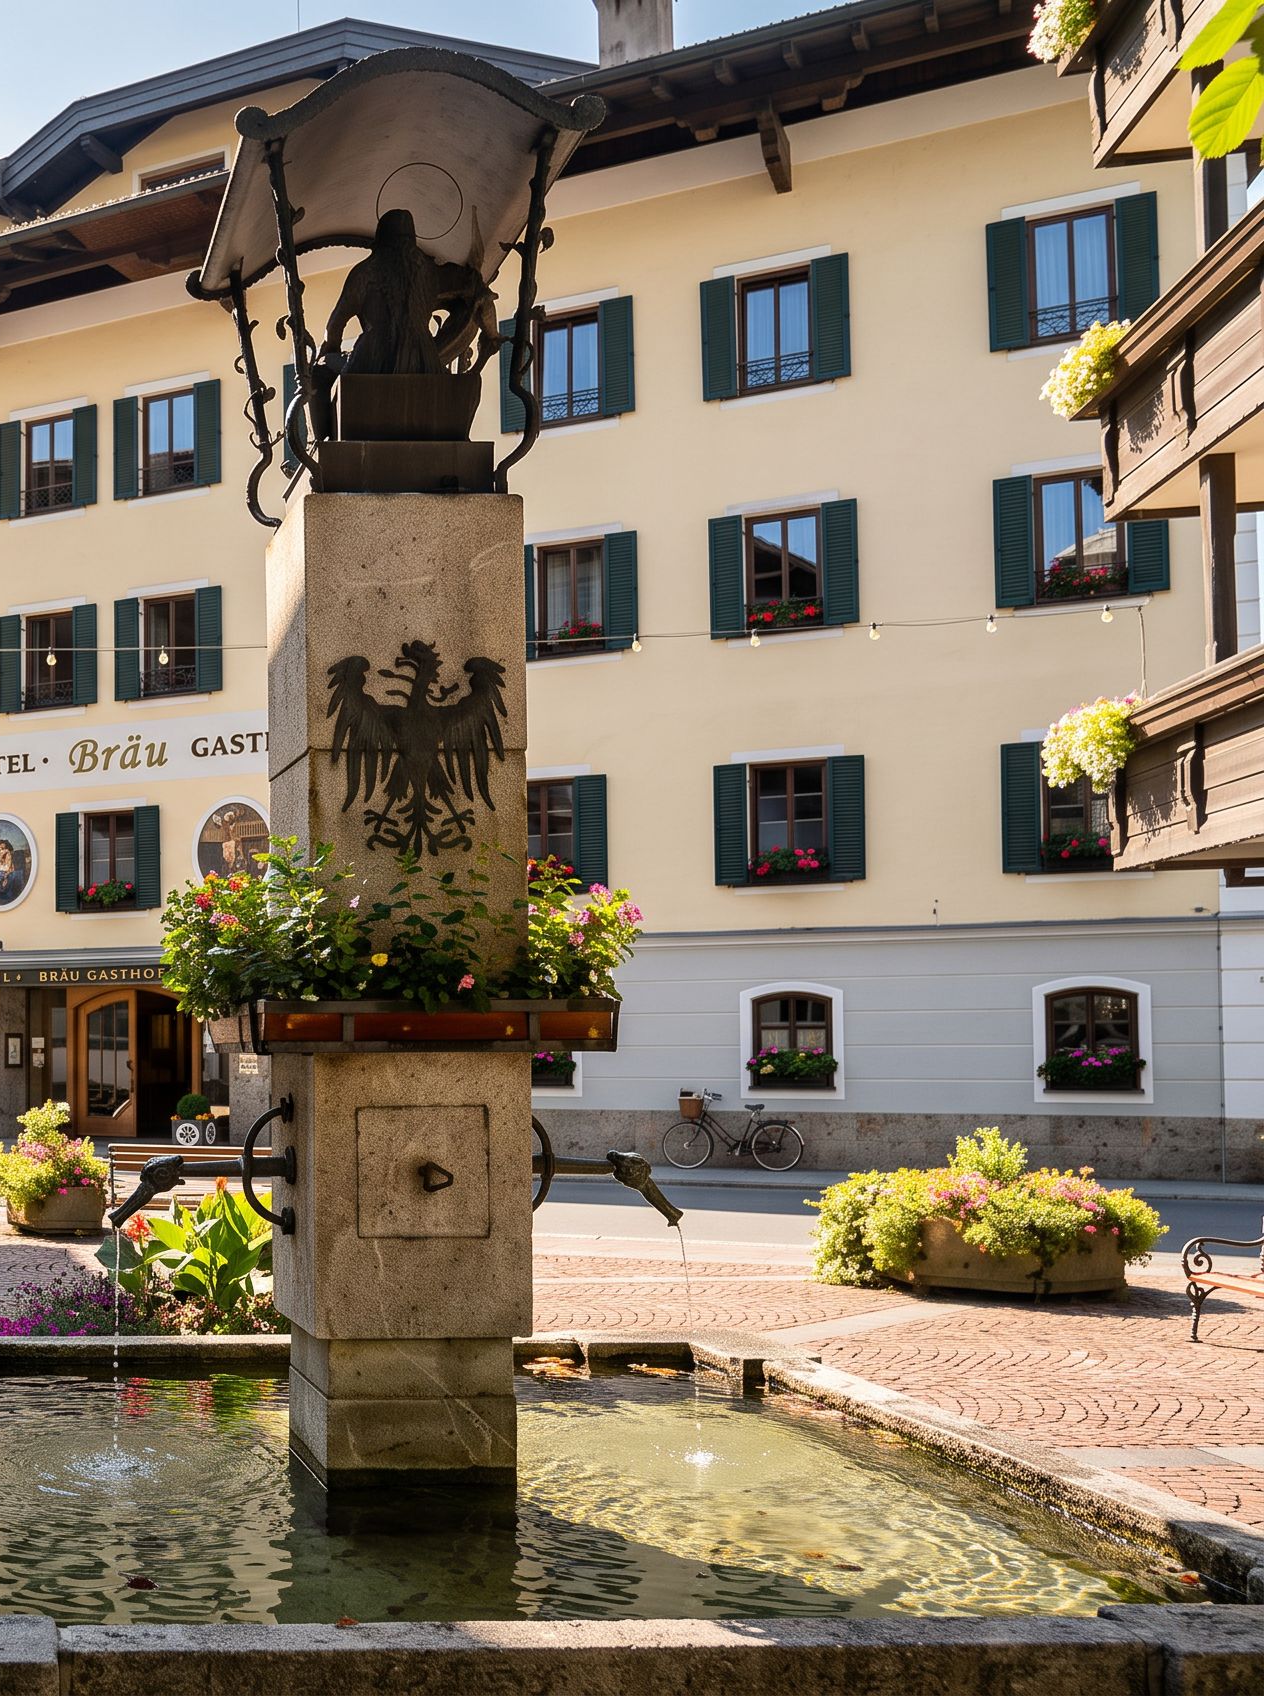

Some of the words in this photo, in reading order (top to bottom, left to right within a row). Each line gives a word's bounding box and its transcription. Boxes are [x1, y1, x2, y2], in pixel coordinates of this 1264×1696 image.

[68, 734, 168, 774] Bräu
[39, 968, 80, 982] BRÄU
[87, 967, 165, 981] GASTHOF
